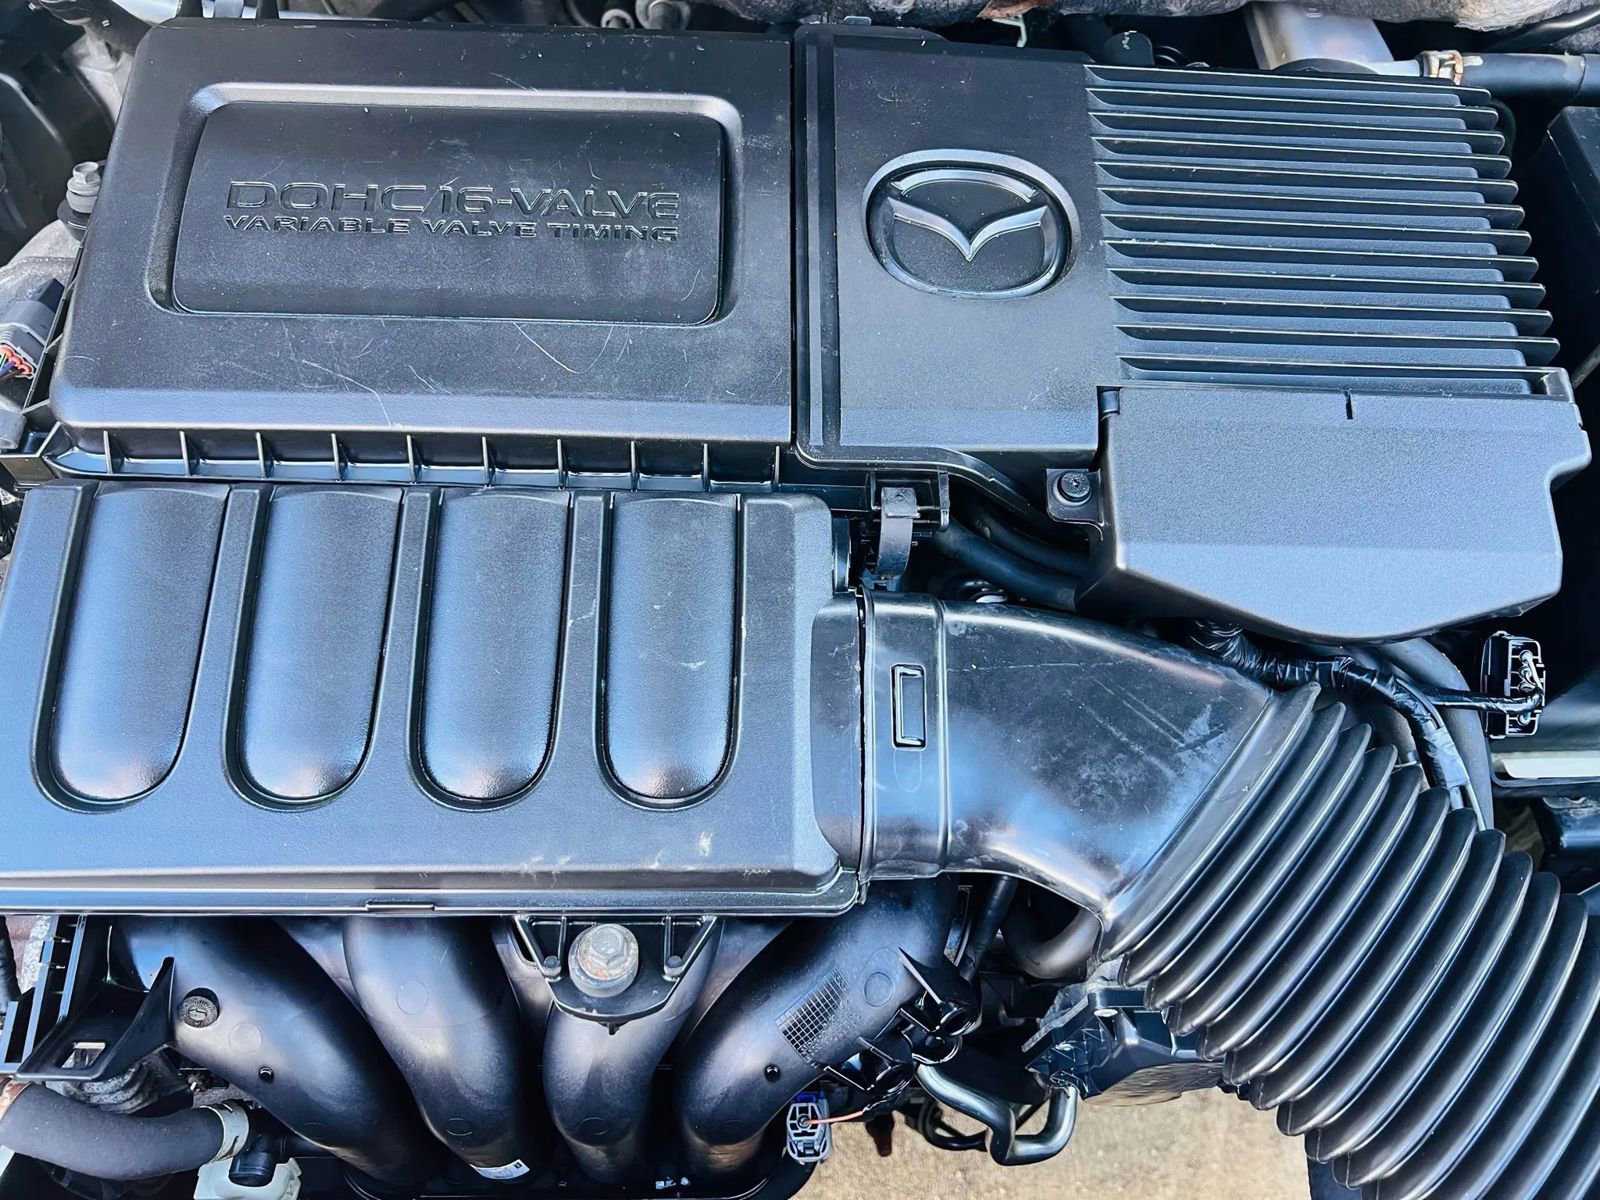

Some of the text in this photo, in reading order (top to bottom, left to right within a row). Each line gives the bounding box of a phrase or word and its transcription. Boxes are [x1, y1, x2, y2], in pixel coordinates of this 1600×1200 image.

[227, 180, 427, 212] DOHC
[223, 215, 679, 241] VARIABLE VALVE TIMING
